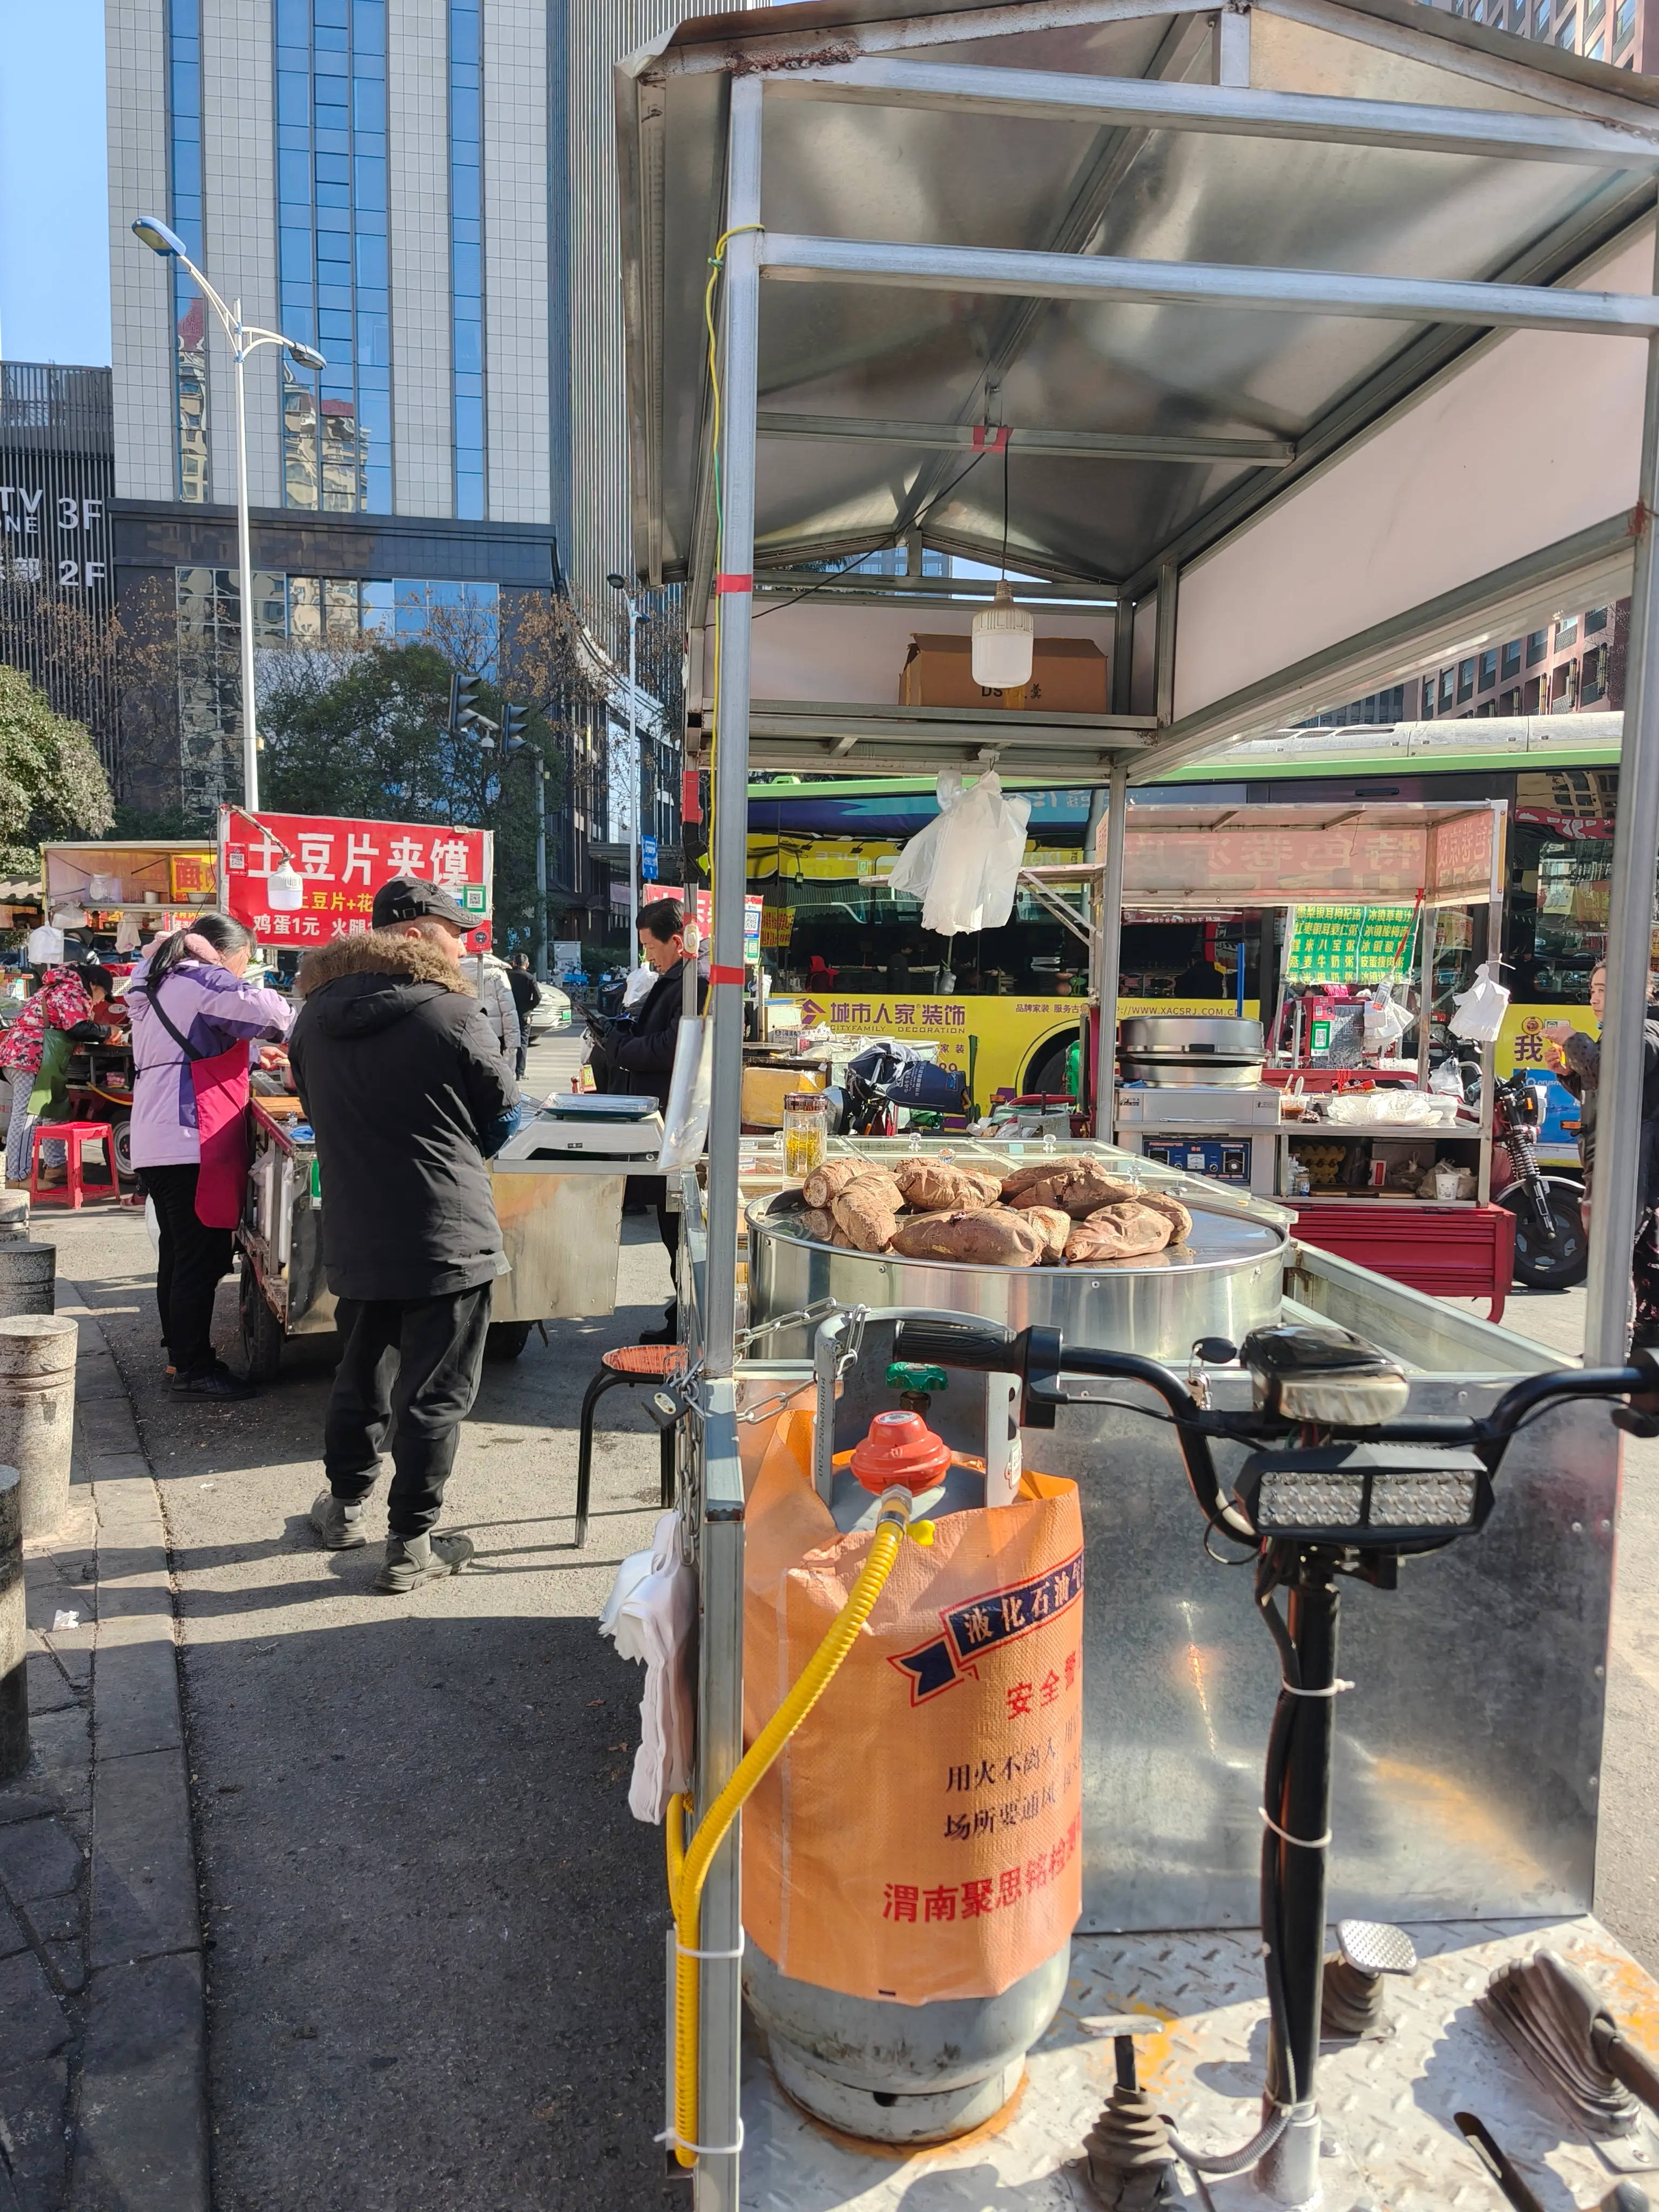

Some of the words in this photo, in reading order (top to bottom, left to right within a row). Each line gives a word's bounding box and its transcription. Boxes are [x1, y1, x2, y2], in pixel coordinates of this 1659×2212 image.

[0, 515, 38, 534] NE
[58, 497, 102, 530] 3F
[58, 560, 104, 587] 2F
[248, 828, 469, 885] 土豆片夹馍
[253, 914, 320, 936] 鸡蛋1元
[1016, 1004, 1049, 1013] 品牌家装
[1514, 1035, 1543, 1062] 我
